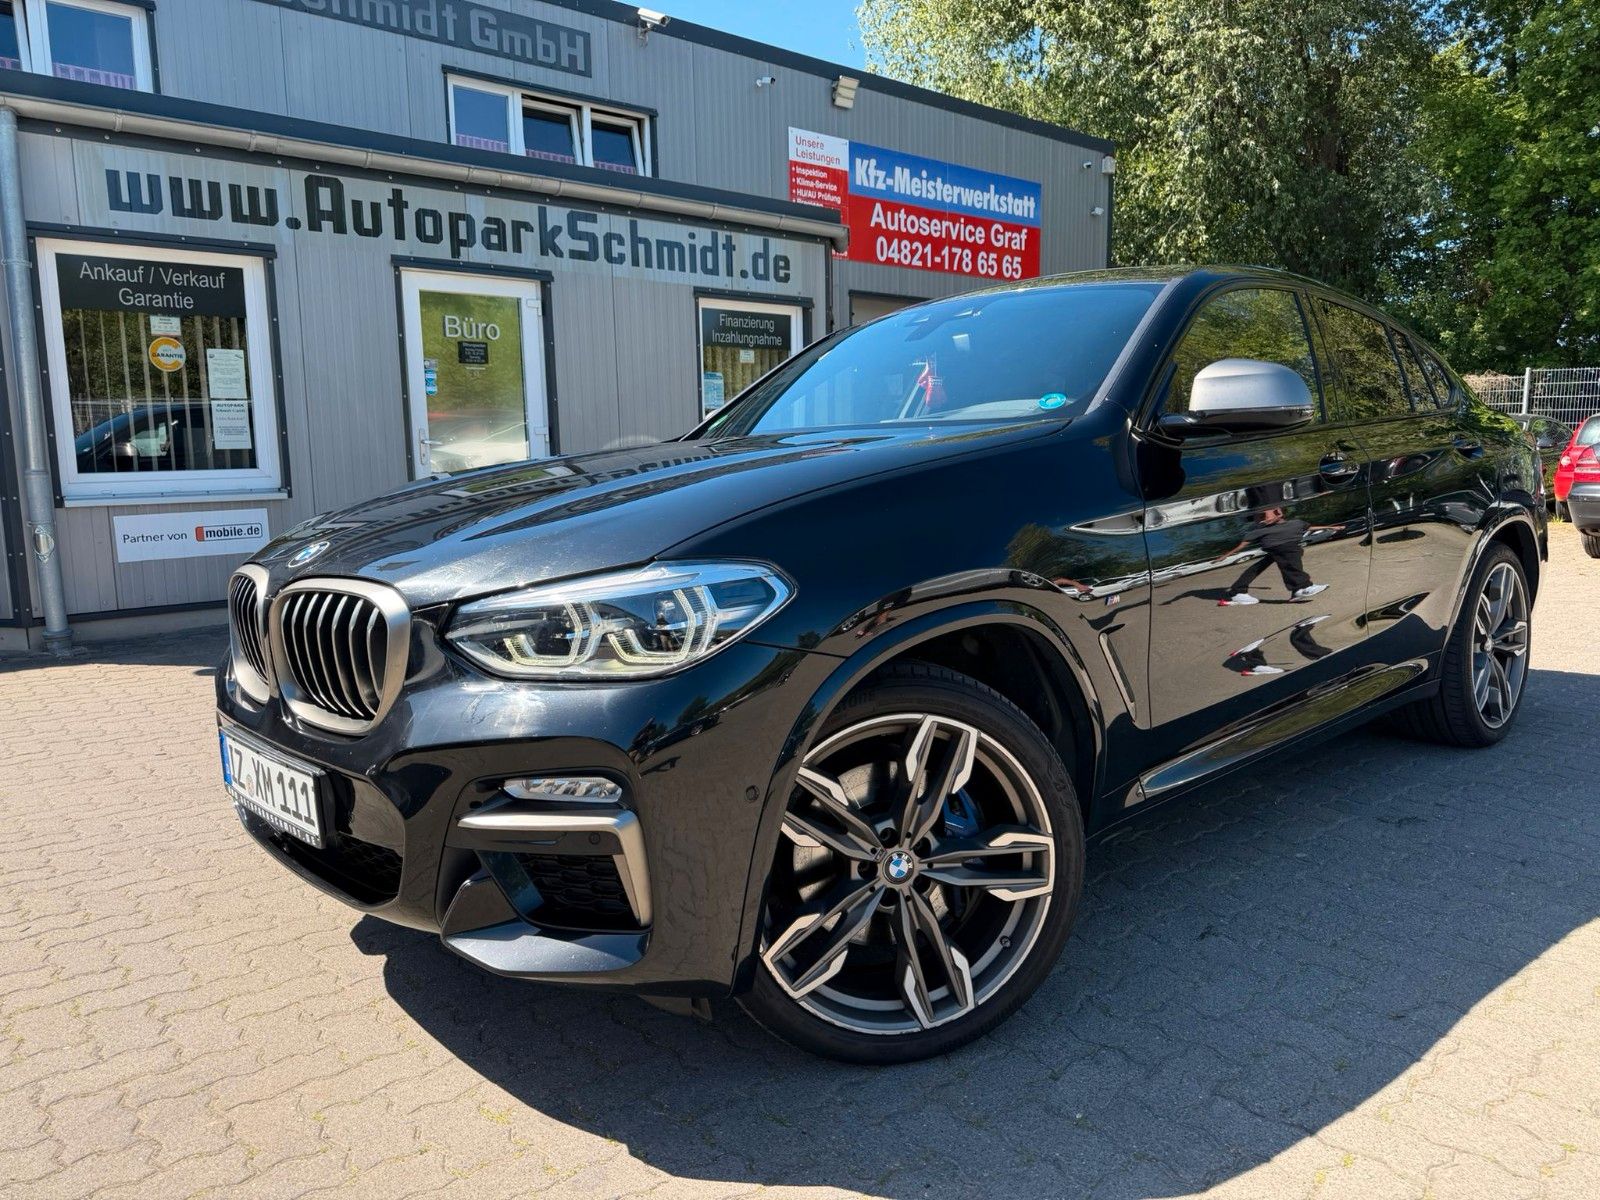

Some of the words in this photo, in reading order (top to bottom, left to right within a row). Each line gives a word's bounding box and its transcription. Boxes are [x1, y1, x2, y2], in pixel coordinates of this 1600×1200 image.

[270, 0, 457, 41] midt
[469, 7, 586, 72] GmbH
[796, 136, 825, 150] Unsere
[796, 147, 841, 166] Leistungen
[796, 165, 828, 179] Inspektion
[797, 177, 838, 192] Klima-Service
[855, 157, 1036, 219] Kfz-Meisterwerkstatt
[797, 188, 817, 199] HU/AU
[818, 191, 842, 204] Prüfung
[105, 168, 791, 284] www.AutoparkSchmidt.de
[870, 203, 986, 245] Autoservice
[990, 223, 1028, 251] Graf
[876, 236, 973, 273] 04821-178
[977, 251, 998, 276] 65
[1002, 255, 1022, 280] 65
[79, 261, 145, 284] Ankauf
[160, 267, 226, 289] Verkauf
[118, 288, 194, 310] Garantie
[444, 315, 501, 341] Büro
[720, 314, 775, 333] Finanzierung
[712, 330, 783, 347] Inzahlungnahme
[123, 533, 164, 544] Partner
[168, 531, 188, 541] von
[205, 525, 260, 538] mobile.de
